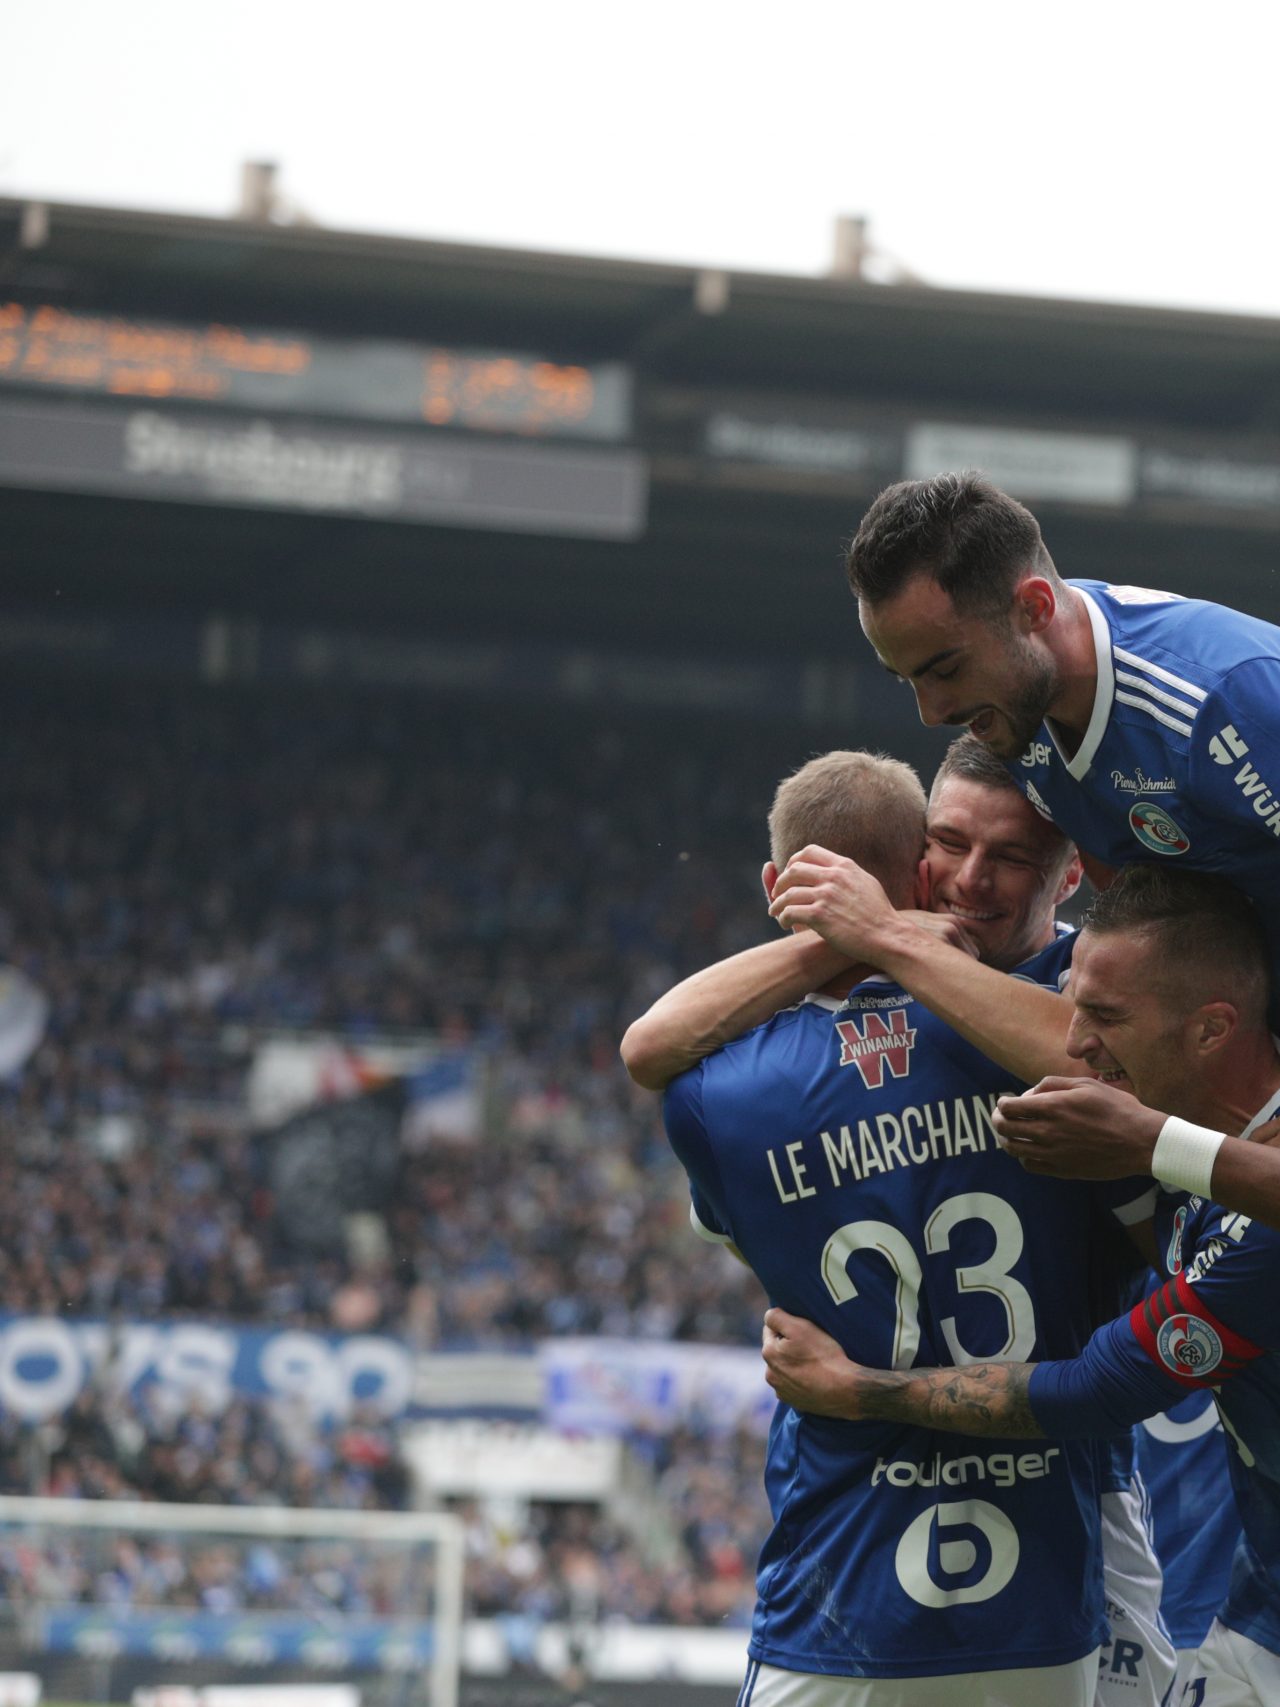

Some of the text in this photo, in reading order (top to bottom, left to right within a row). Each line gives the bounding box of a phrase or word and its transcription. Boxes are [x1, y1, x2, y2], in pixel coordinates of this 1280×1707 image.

[848, 1032, 910, 1058] WINAMAX
[766, 1090, 1012, 1204] LE MARCHAN
[820, 1192, 1037, 1371] 23
